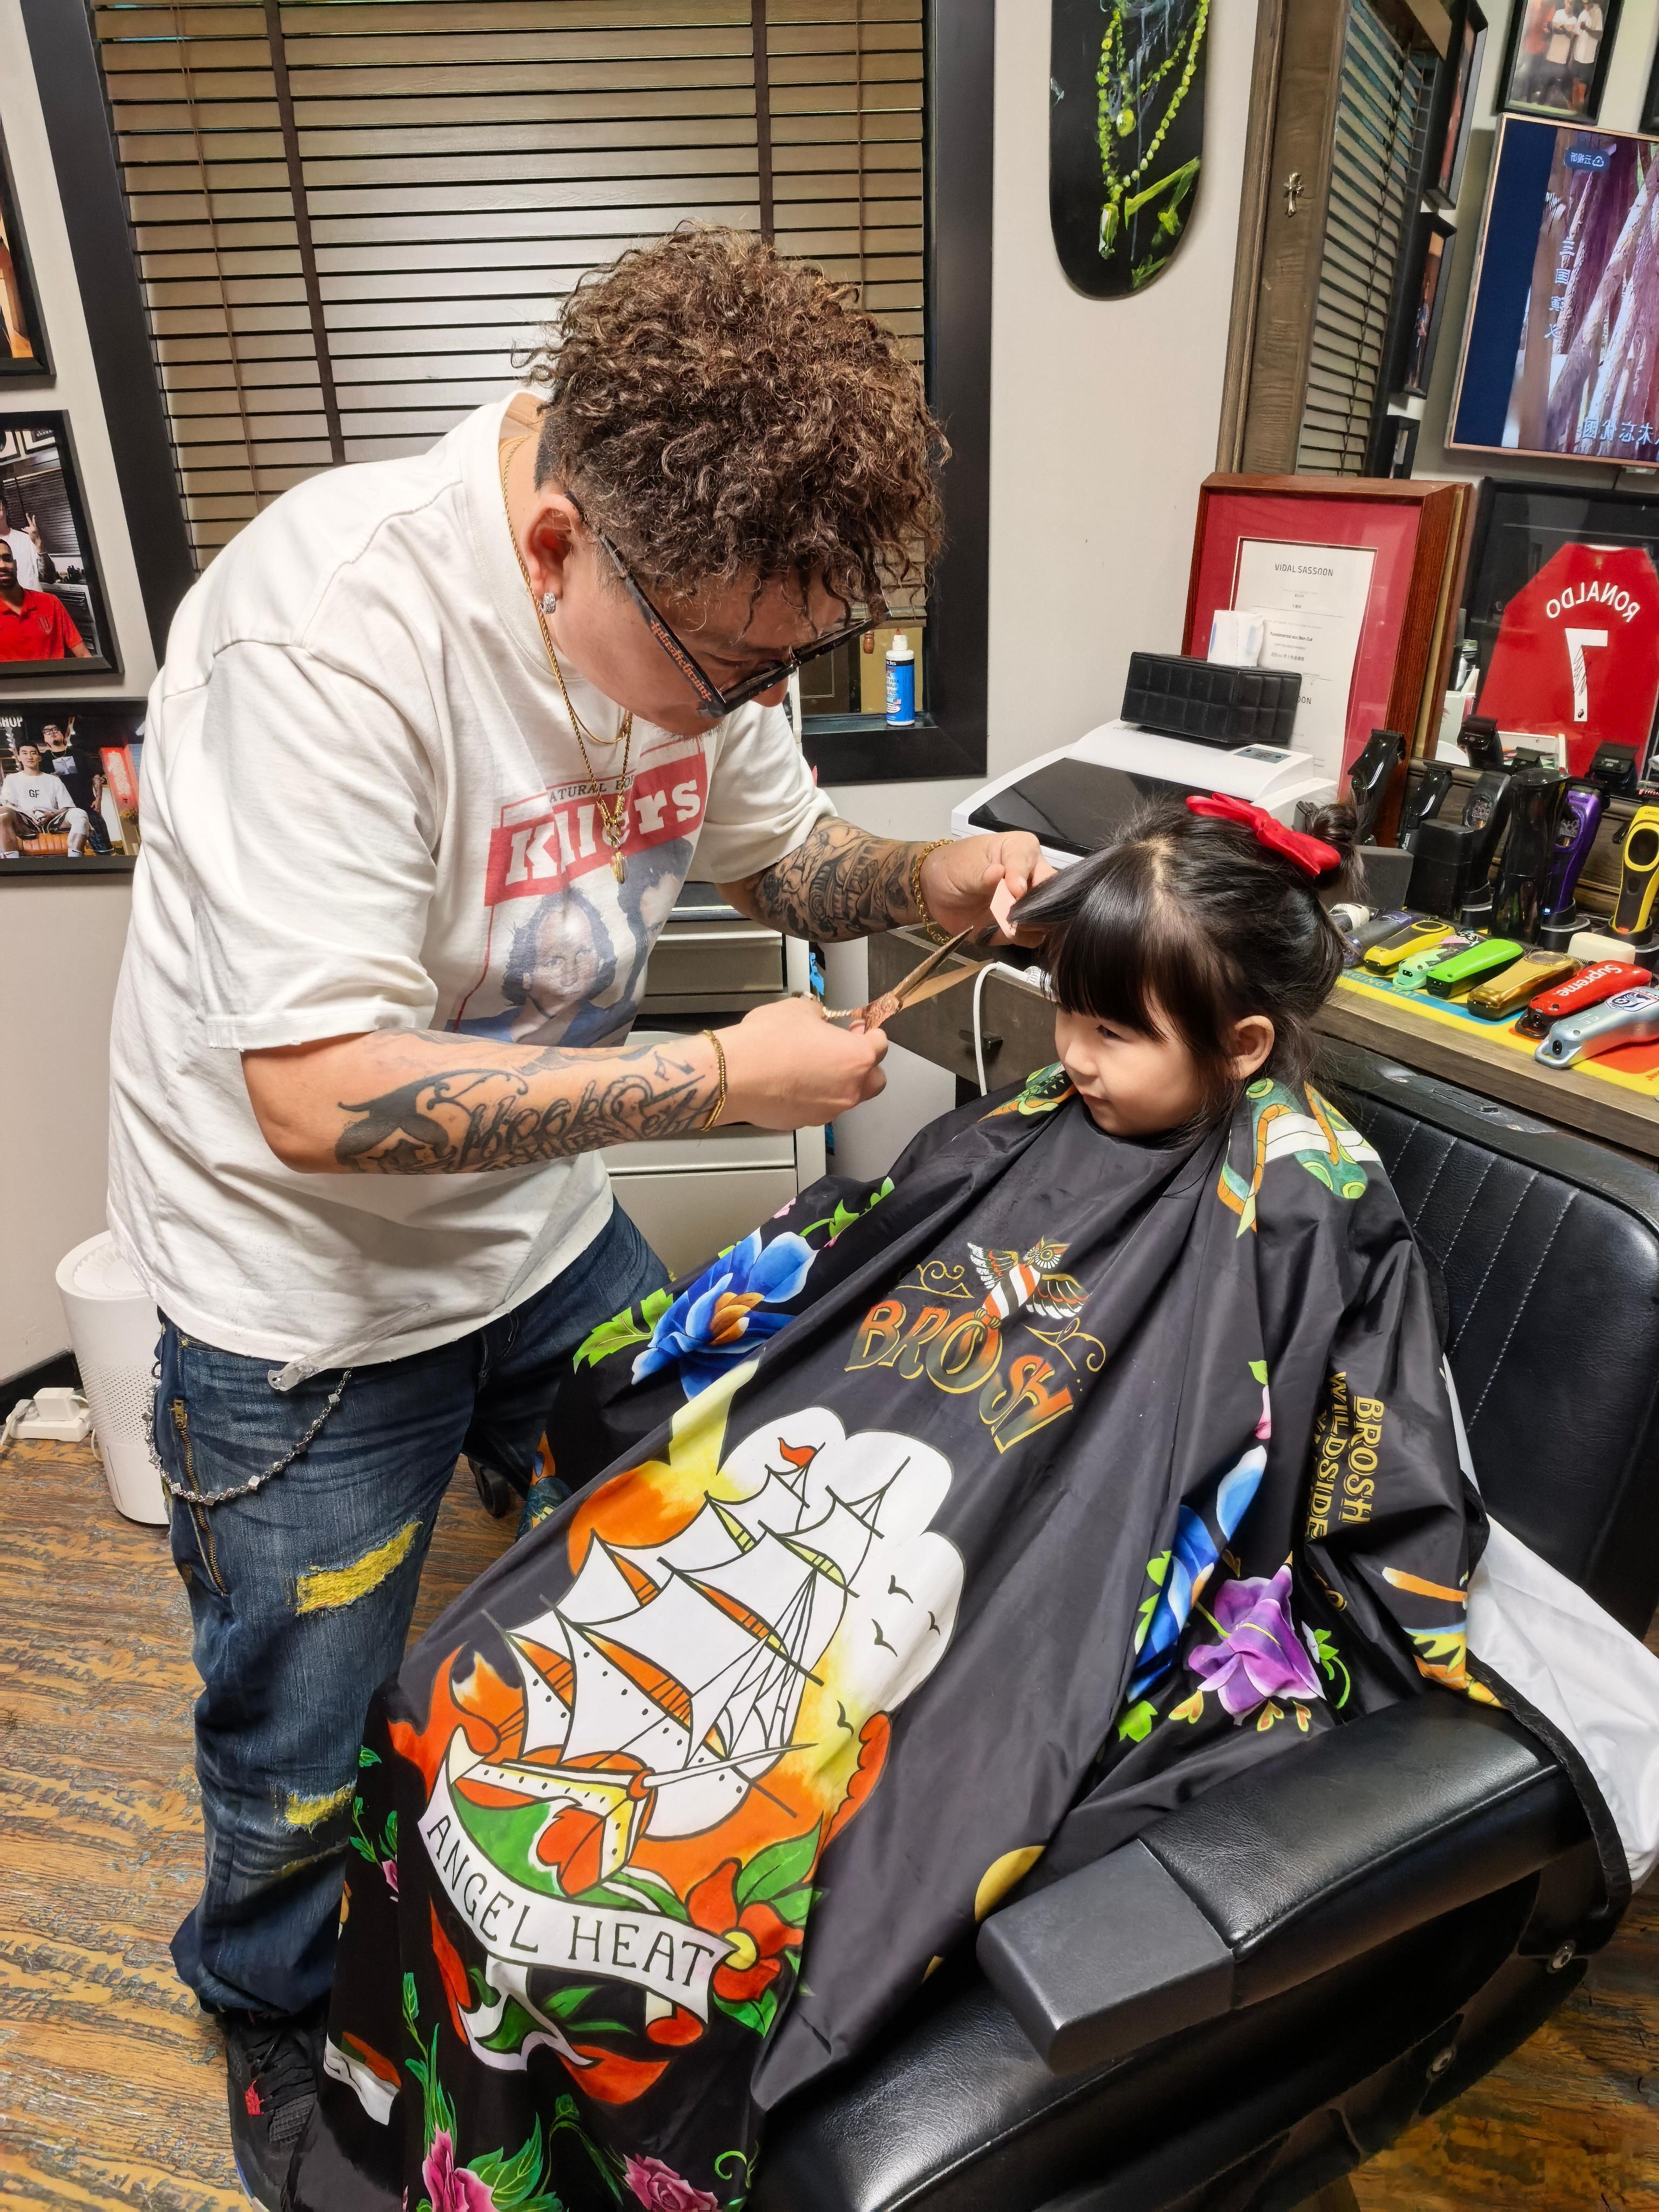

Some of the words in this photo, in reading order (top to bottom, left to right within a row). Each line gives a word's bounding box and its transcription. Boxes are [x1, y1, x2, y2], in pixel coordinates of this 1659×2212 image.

[1275, 563, 1296, 573] VIDAL
[1298, 566, 1334, 576] SASSOON
[0, 717, 23, 727] HOP
[29, 789, 40, 798] GF
[549, 784, 606, 803] ATURAL
[505, 779, 700, 886] Kllers
[1555, 963, 1623, 996] Supreme
[844, 1299, 1074, 1454] BROSH
[1306, 1371, 1349, 1539] WILDSIDE
[1338, 1395, 1385, 1525] BROSH
[427, 1815, 539, 1953] ANGEL
[568, 1915, 716, 1988] HEAT
